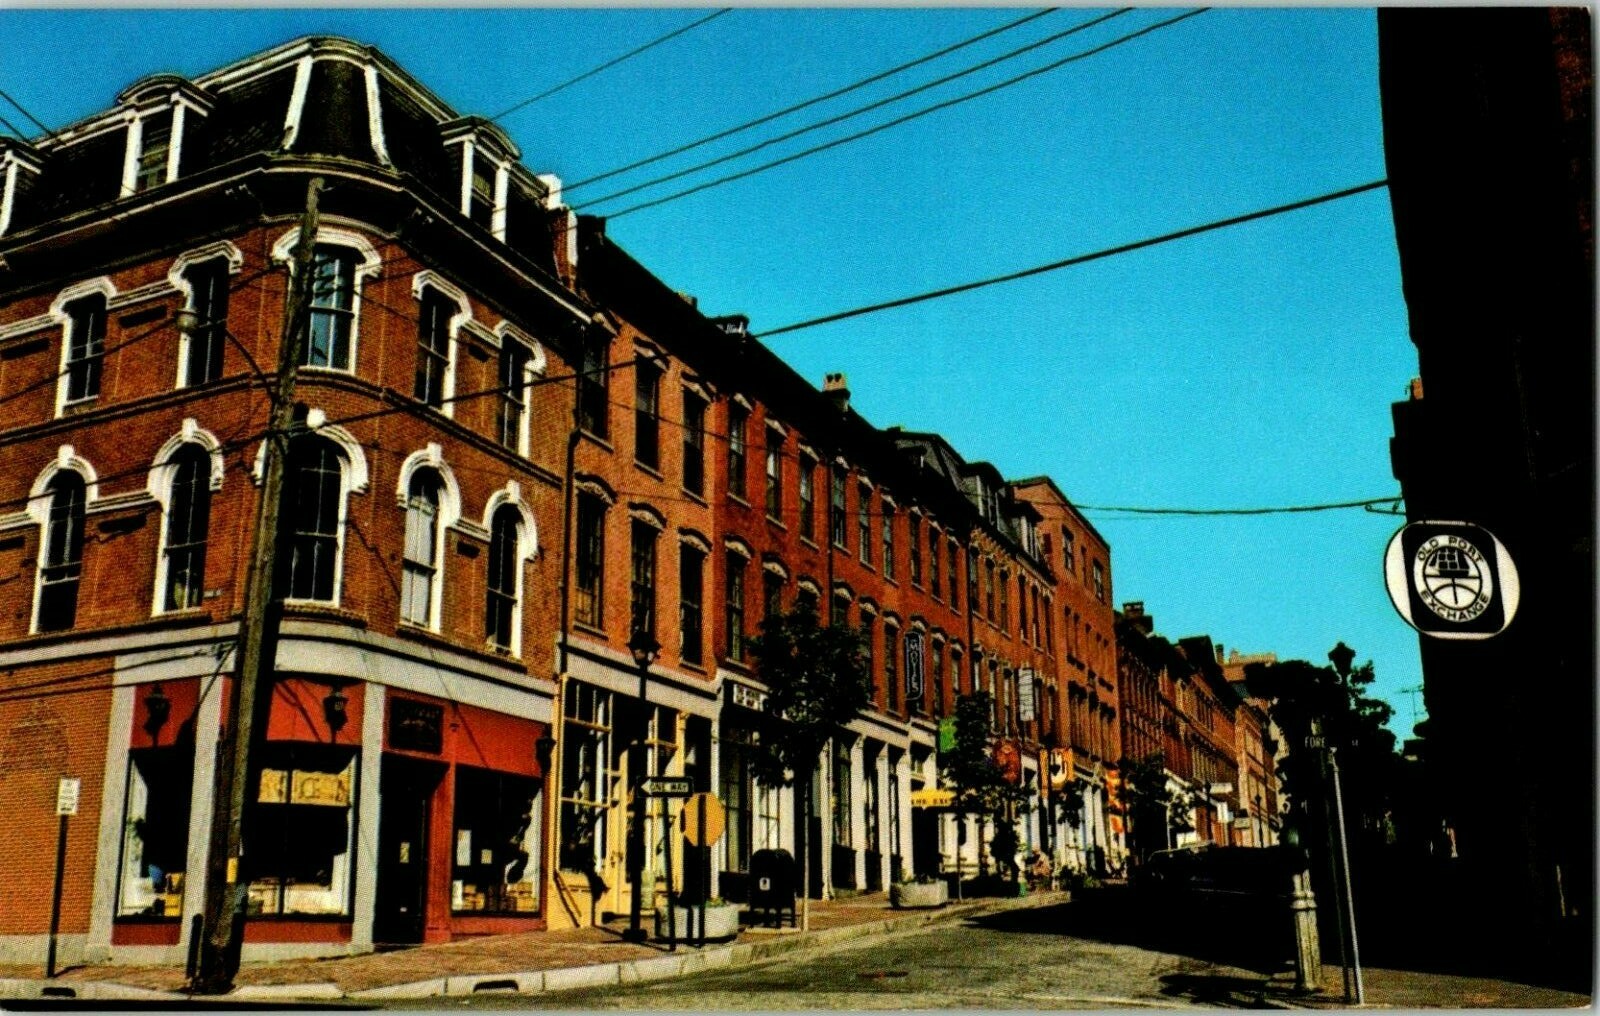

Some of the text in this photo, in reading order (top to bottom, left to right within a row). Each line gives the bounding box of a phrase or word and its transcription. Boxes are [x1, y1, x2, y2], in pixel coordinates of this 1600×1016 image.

[1418, 536, 1484, 563] OLD PORT
[1421, 590, 1489, 620] EXCHANGE
[910, 642, 919, 692] MOVIES
[1304, 735, 1326, 748] FORE
[651, 781, 689, 793] ONE WAY
